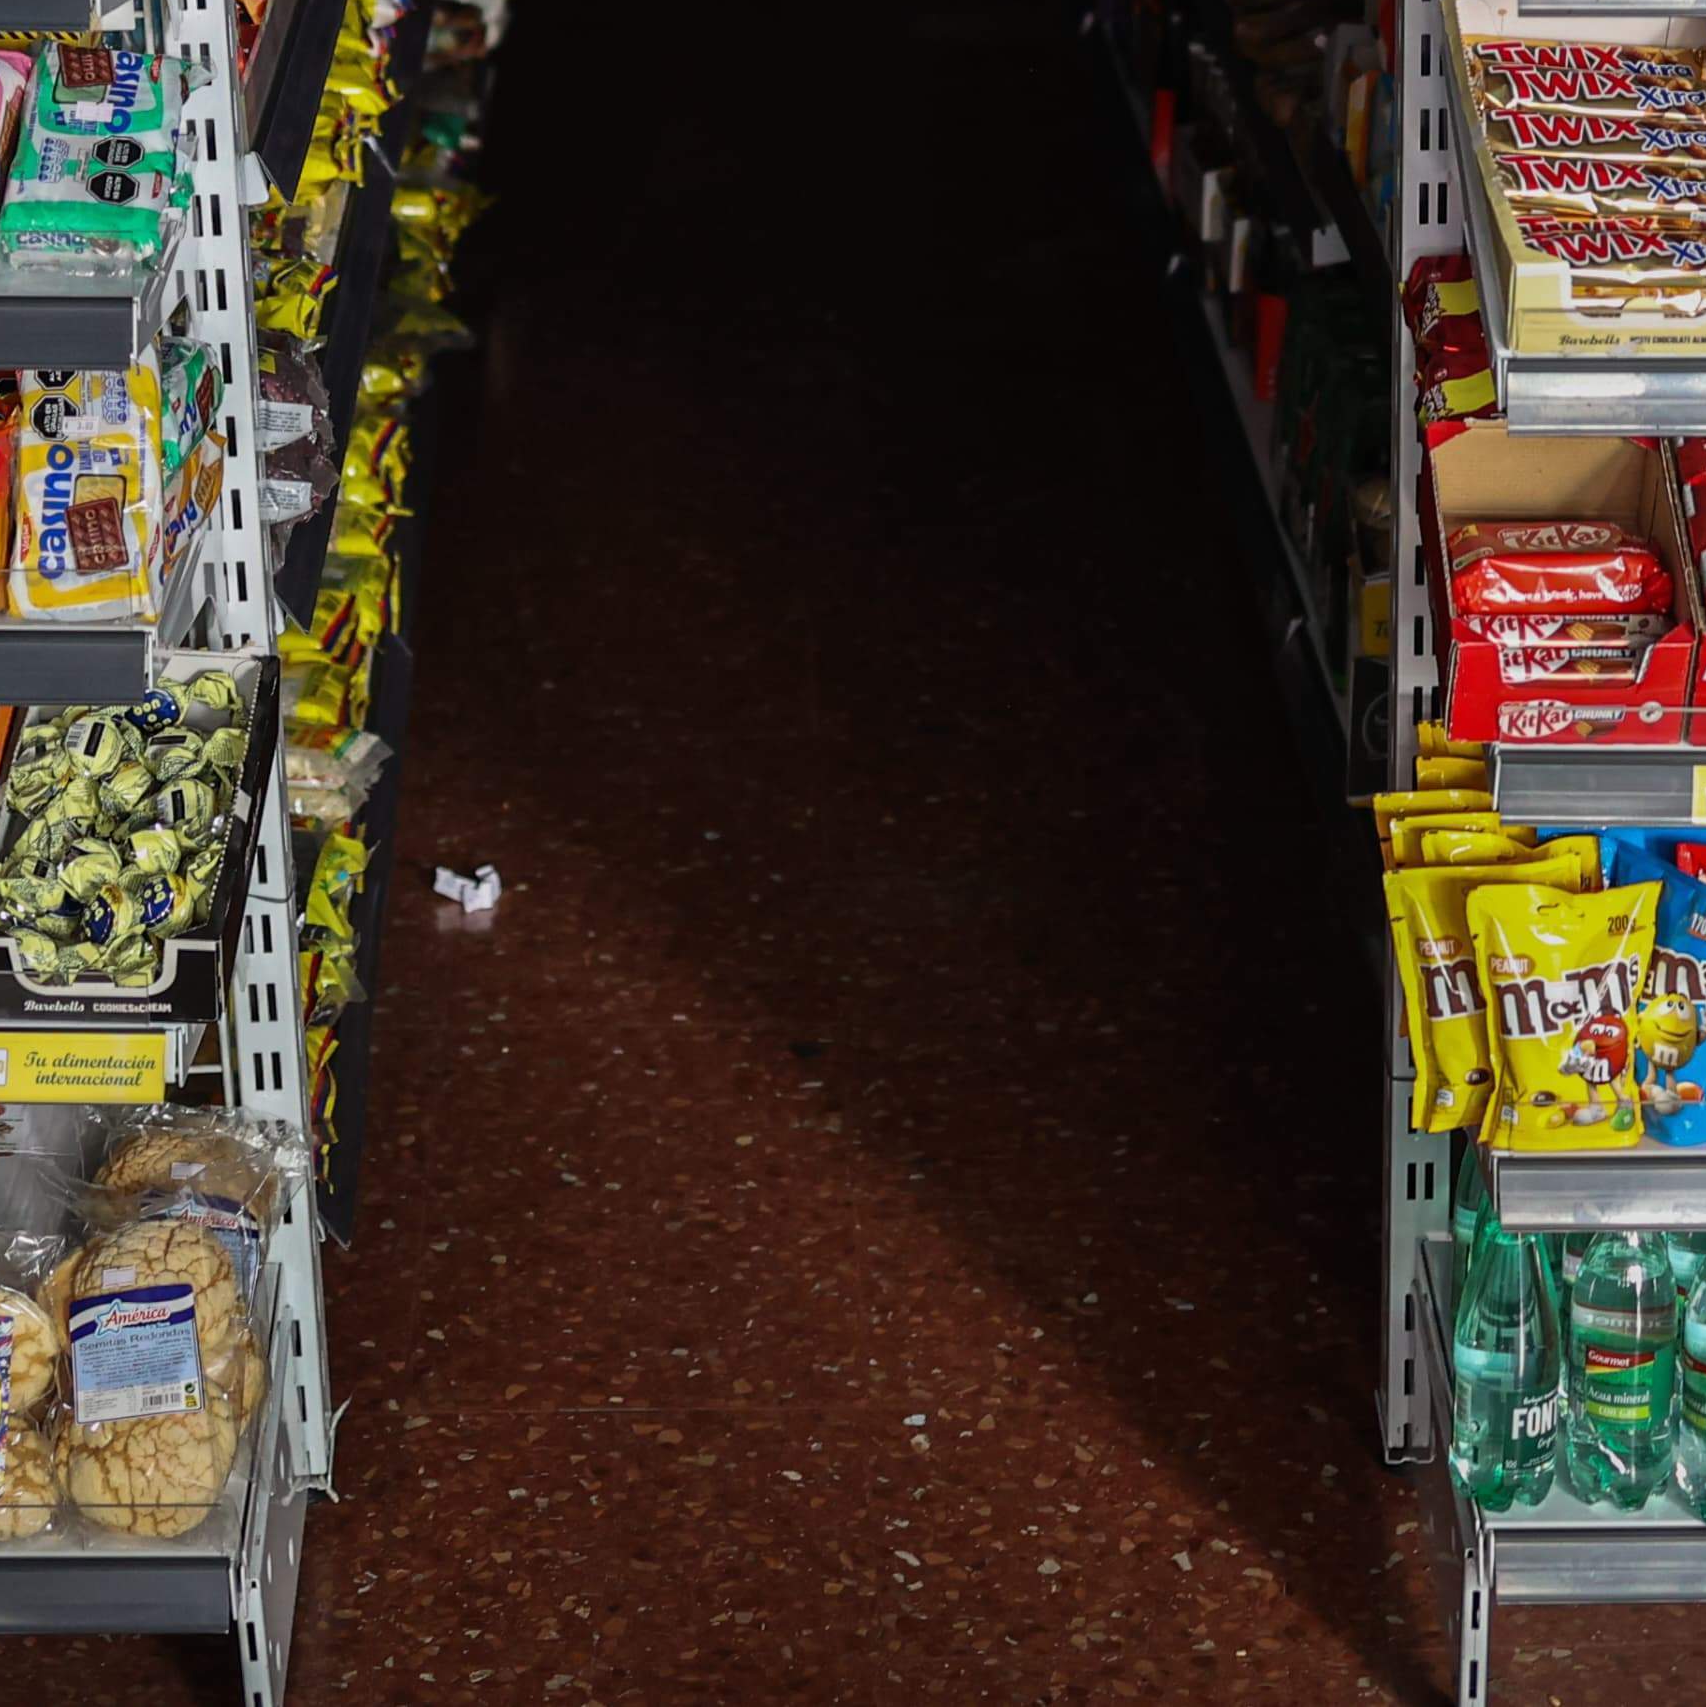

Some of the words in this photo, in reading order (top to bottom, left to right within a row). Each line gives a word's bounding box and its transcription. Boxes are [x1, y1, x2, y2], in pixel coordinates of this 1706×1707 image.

[1496, 110, 1643, 149] TWIX
[37, 444, 75, 580] casino
[1503, 702, 1571, 736] KitKat
[1491, 956, 1529, 973] PEANUT
[105, 1303, 170, 1328] América
[1587, 1348, 1632, 1368] Gourmet
